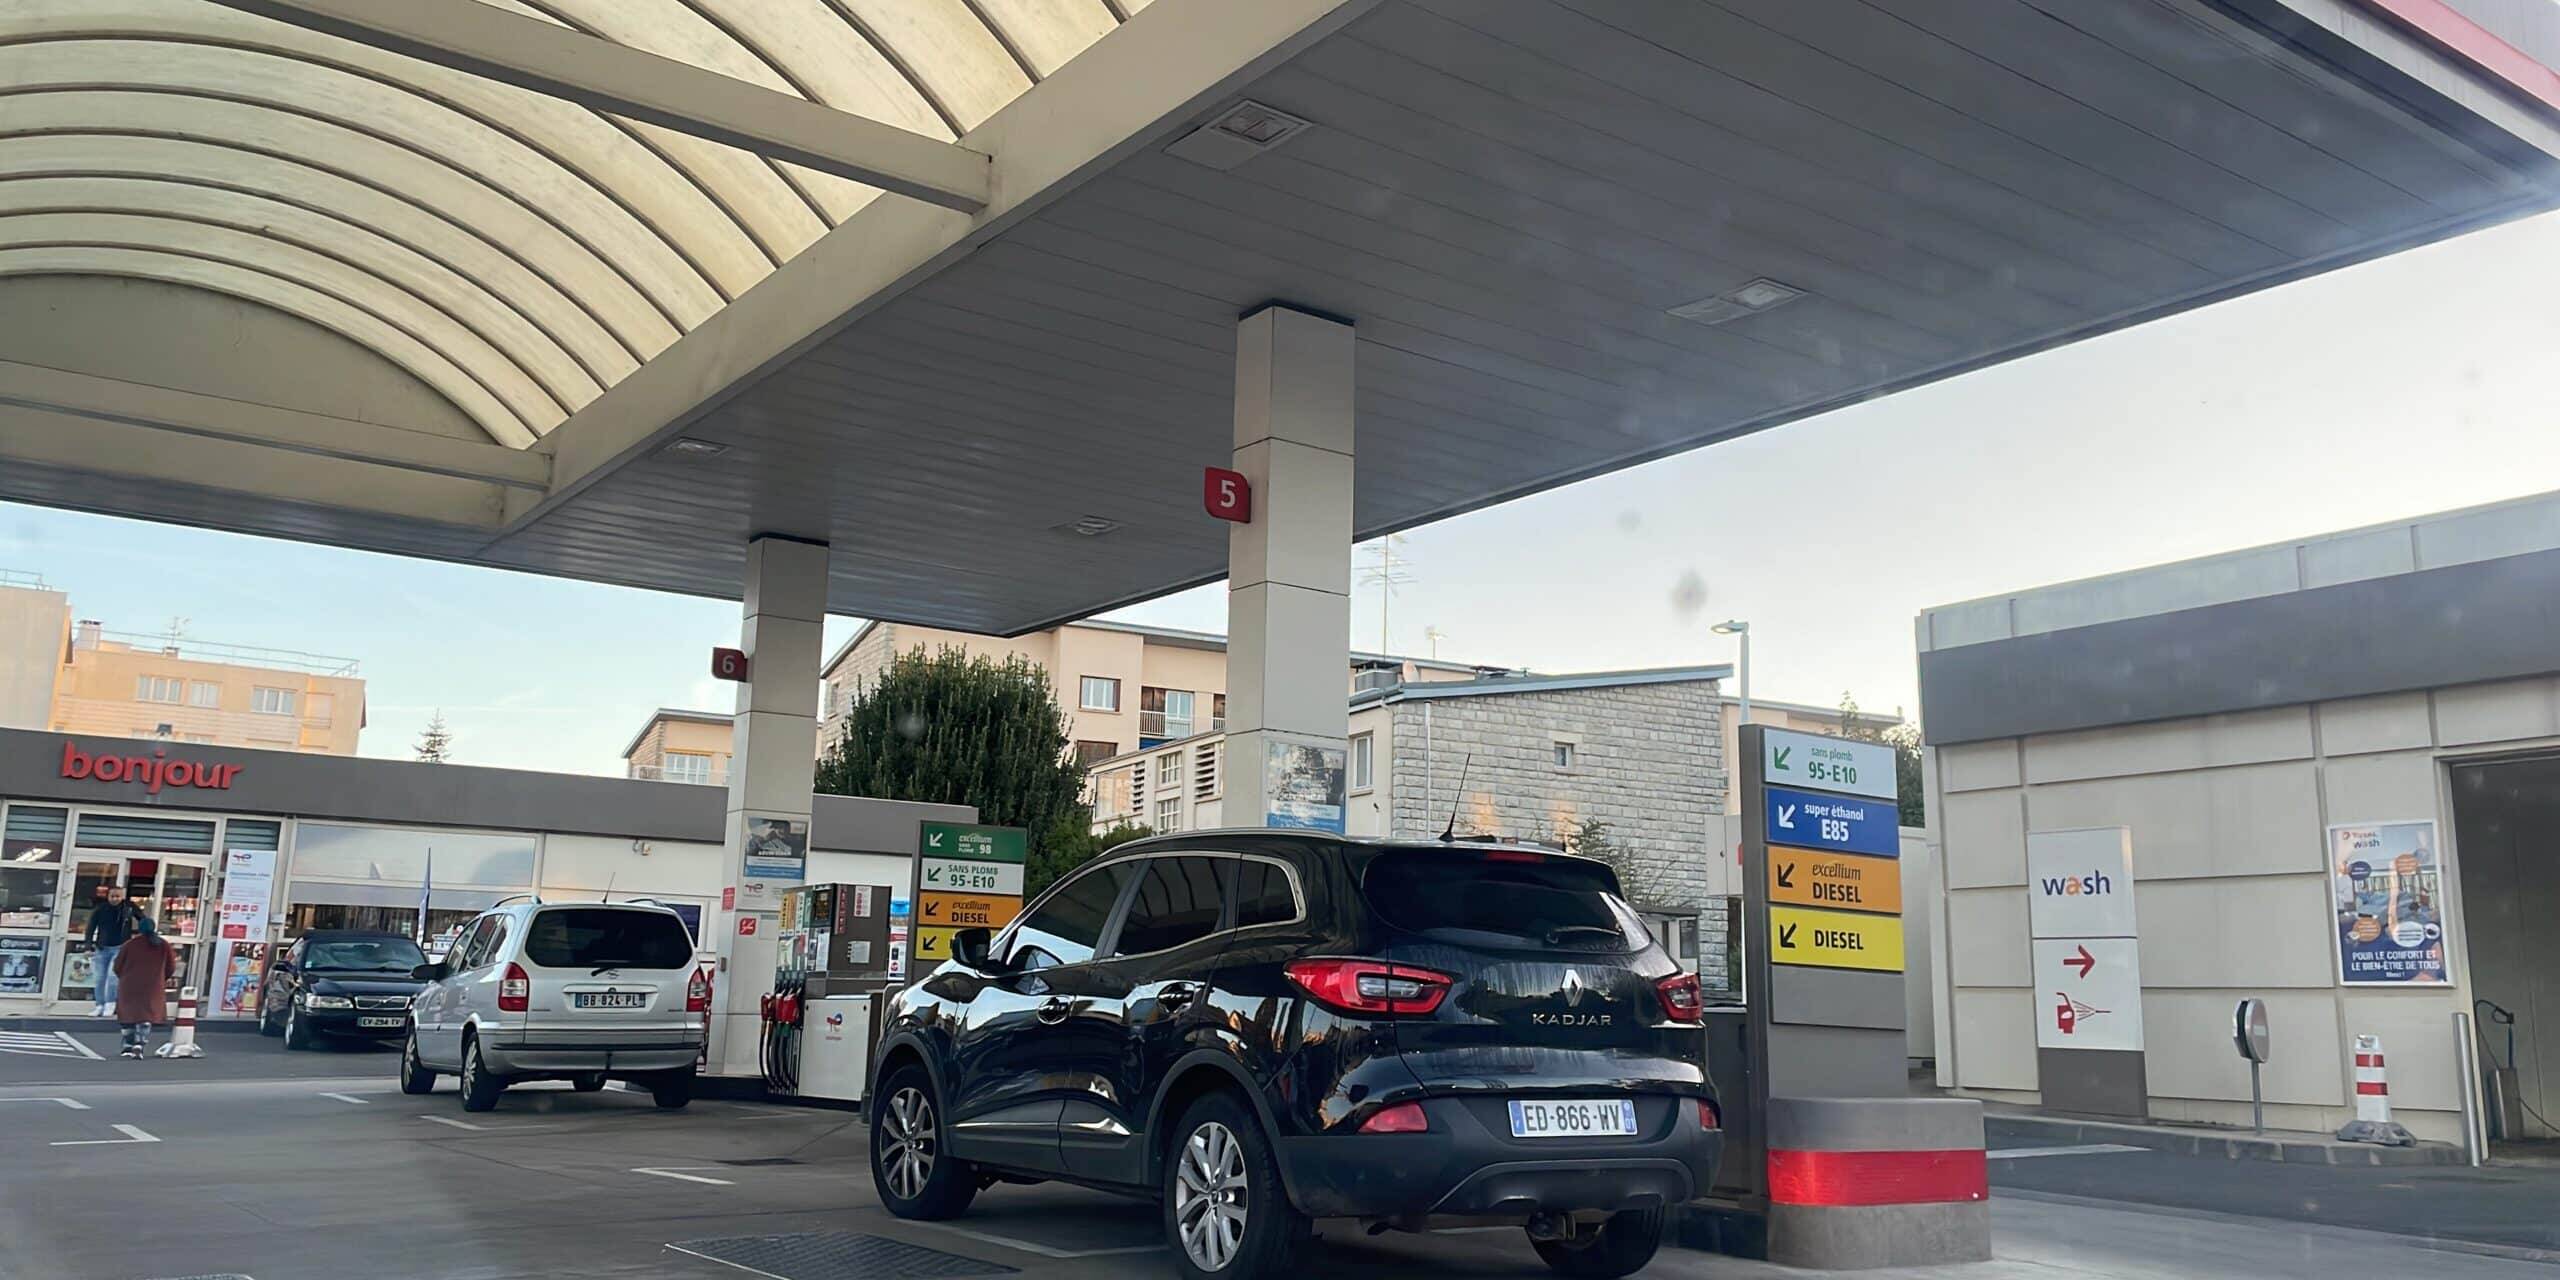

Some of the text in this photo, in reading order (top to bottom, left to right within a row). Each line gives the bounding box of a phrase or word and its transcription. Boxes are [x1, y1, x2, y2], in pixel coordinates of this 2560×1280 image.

[1220, 480, 1235, 508] 5
[722, 654, 735, 674] 6
[1811, 747, 1853, 762] sans plomb
[62, 741, 243, 793] bonjour
[1808, 761, 1857, 785] 95-E10
[1804, 804, 1864, 822] super éthanol
[1821, 818, 1849, 842] E85
[979, 844, 991, 854] 98
[2354, 839, 2380, 849] wash
[948, 864, 999, 876] SANS PLOMB
[1811, 861, 1862, 881] excellium
[950, 874, 995, 889] 95-E10
[2042, 869, 2111, 896] wash
[1812, 882, 1862, 904] DIESEL
[952, 900, 991, 911] excellium
[951, 911, 989, 924] DIESEL
[1814, 929, 1864, 950] DIESEL
[2352, 949, 2436, 961] POUR LE CONFORT ET
[2351, 961, 2361, 971] LE
[2406, 960, 2417, 970] DE
[2418, 960, 2440, 970] TOUS
[1532, 1012, 1612, 1026] KADJAR
